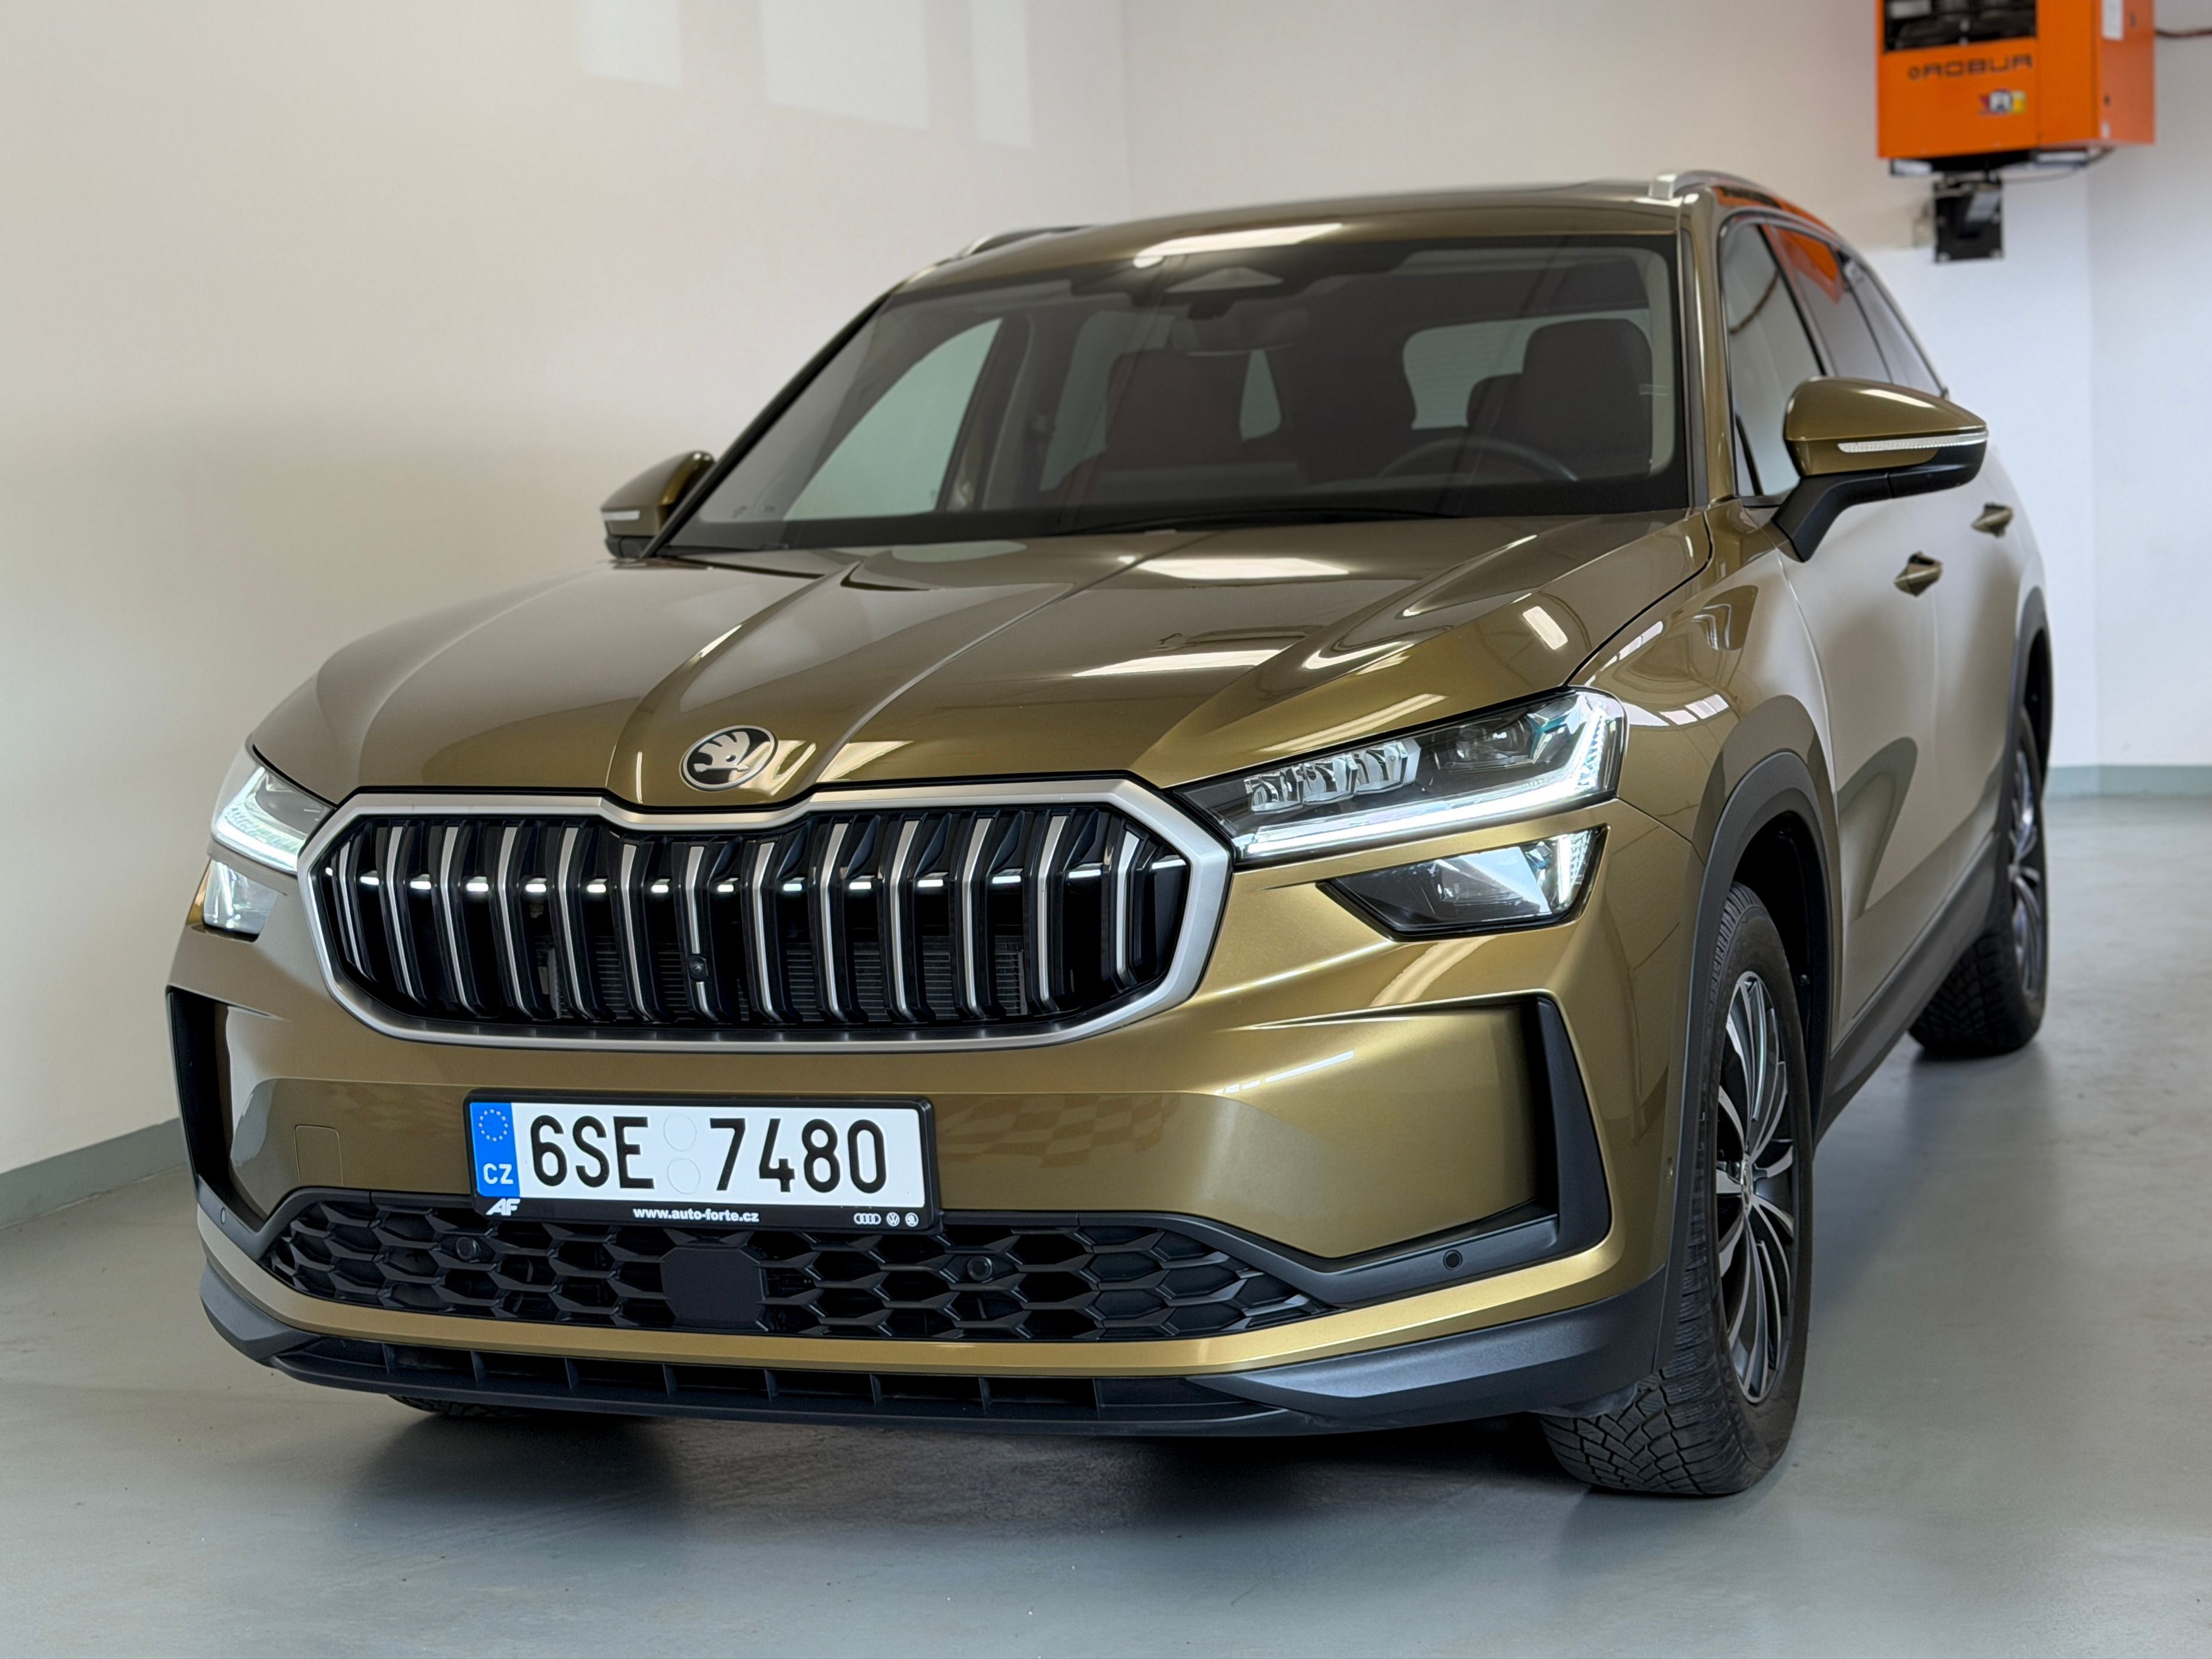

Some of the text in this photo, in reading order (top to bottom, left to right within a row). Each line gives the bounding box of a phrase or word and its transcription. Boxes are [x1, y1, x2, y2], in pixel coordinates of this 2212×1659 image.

[530, 1115, 887, 1193] 6SE 7480
[483, 1163, 514, 1185] CZ
[486, 1198, 521, 1216] AF
[633, 1208, 759, 1222] www.auto-forte.cz
